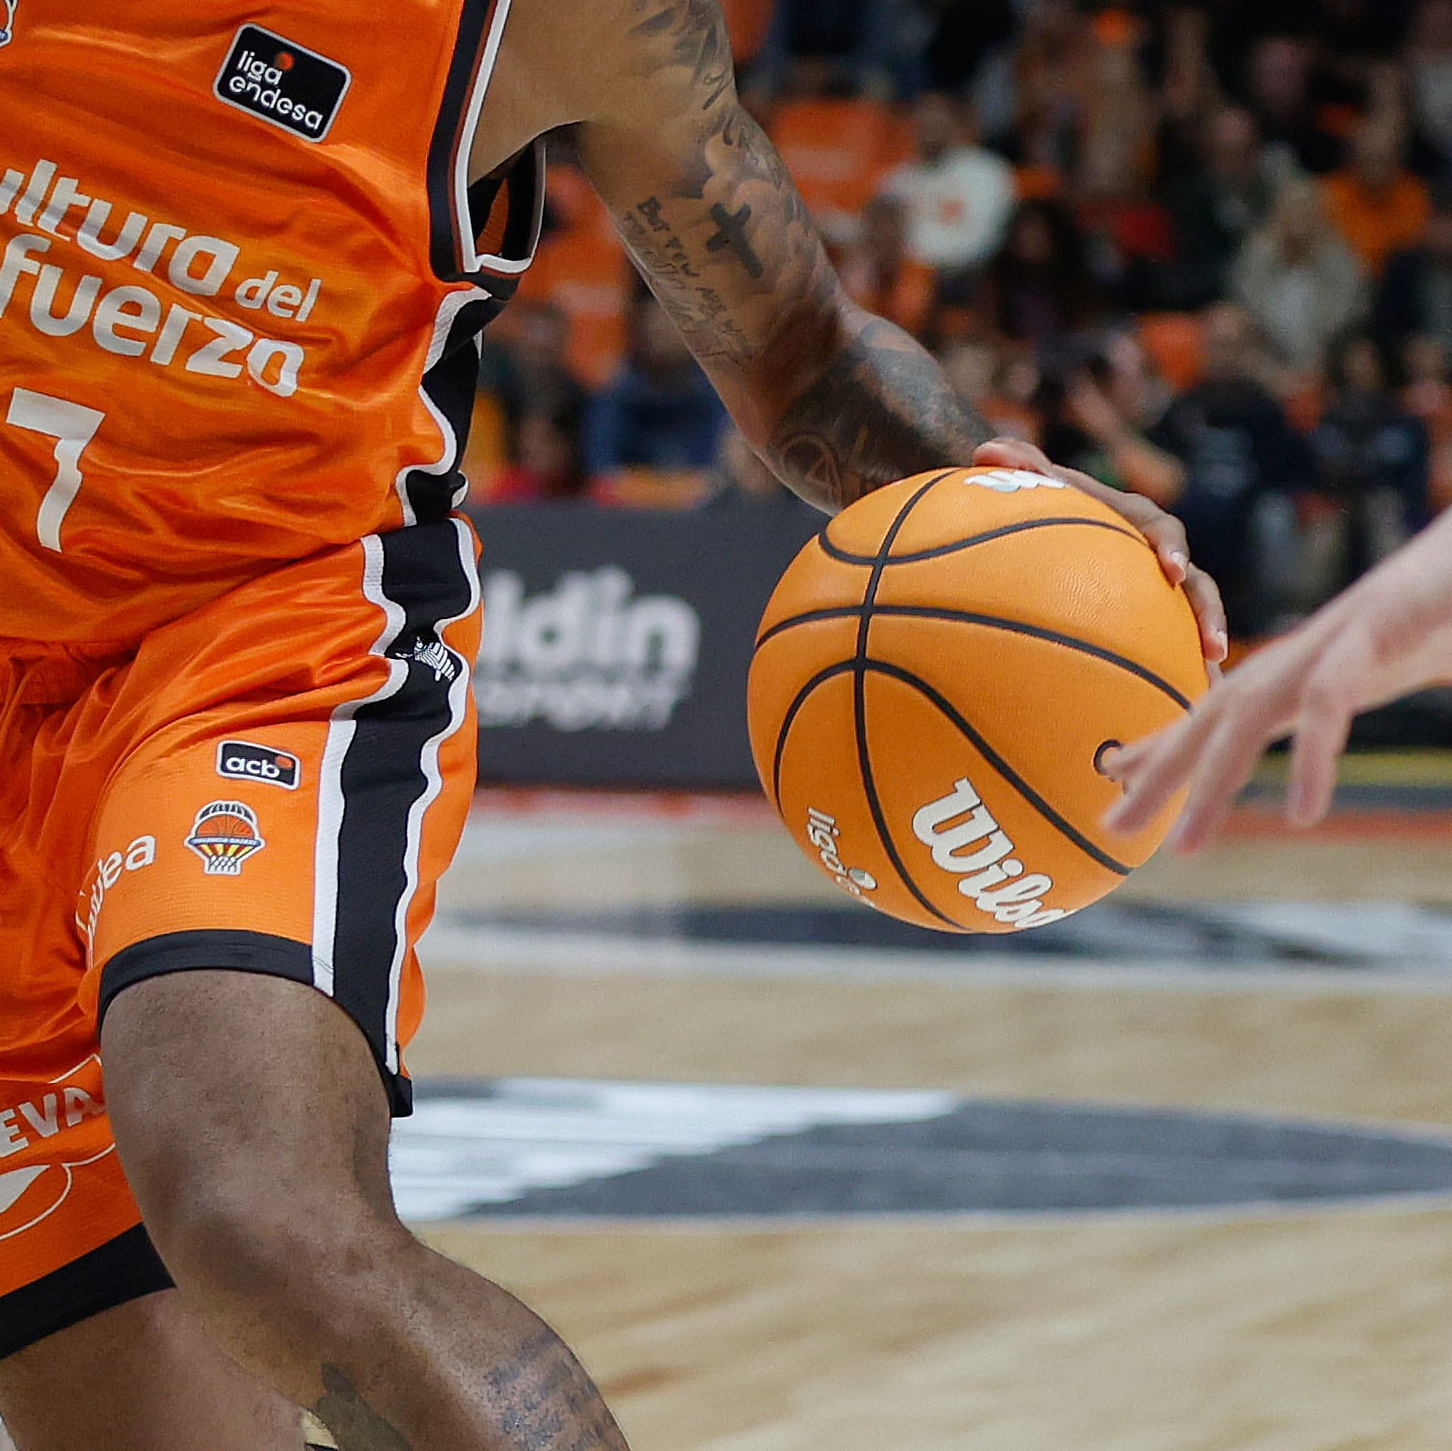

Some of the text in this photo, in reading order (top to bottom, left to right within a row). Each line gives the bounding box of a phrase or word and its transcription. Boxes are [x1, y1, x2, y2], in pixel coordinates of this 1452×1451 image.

[236, 50, 283, 85] liga
[229, 76, 324, 130] endesa
[235, 278, 322, 323] del
[5, 387, 106, 554] 7
[480, 564, 700, 674] ldin
[225, 756, 281, 779] acb
[911, 776, 1071, 929] Wilso
